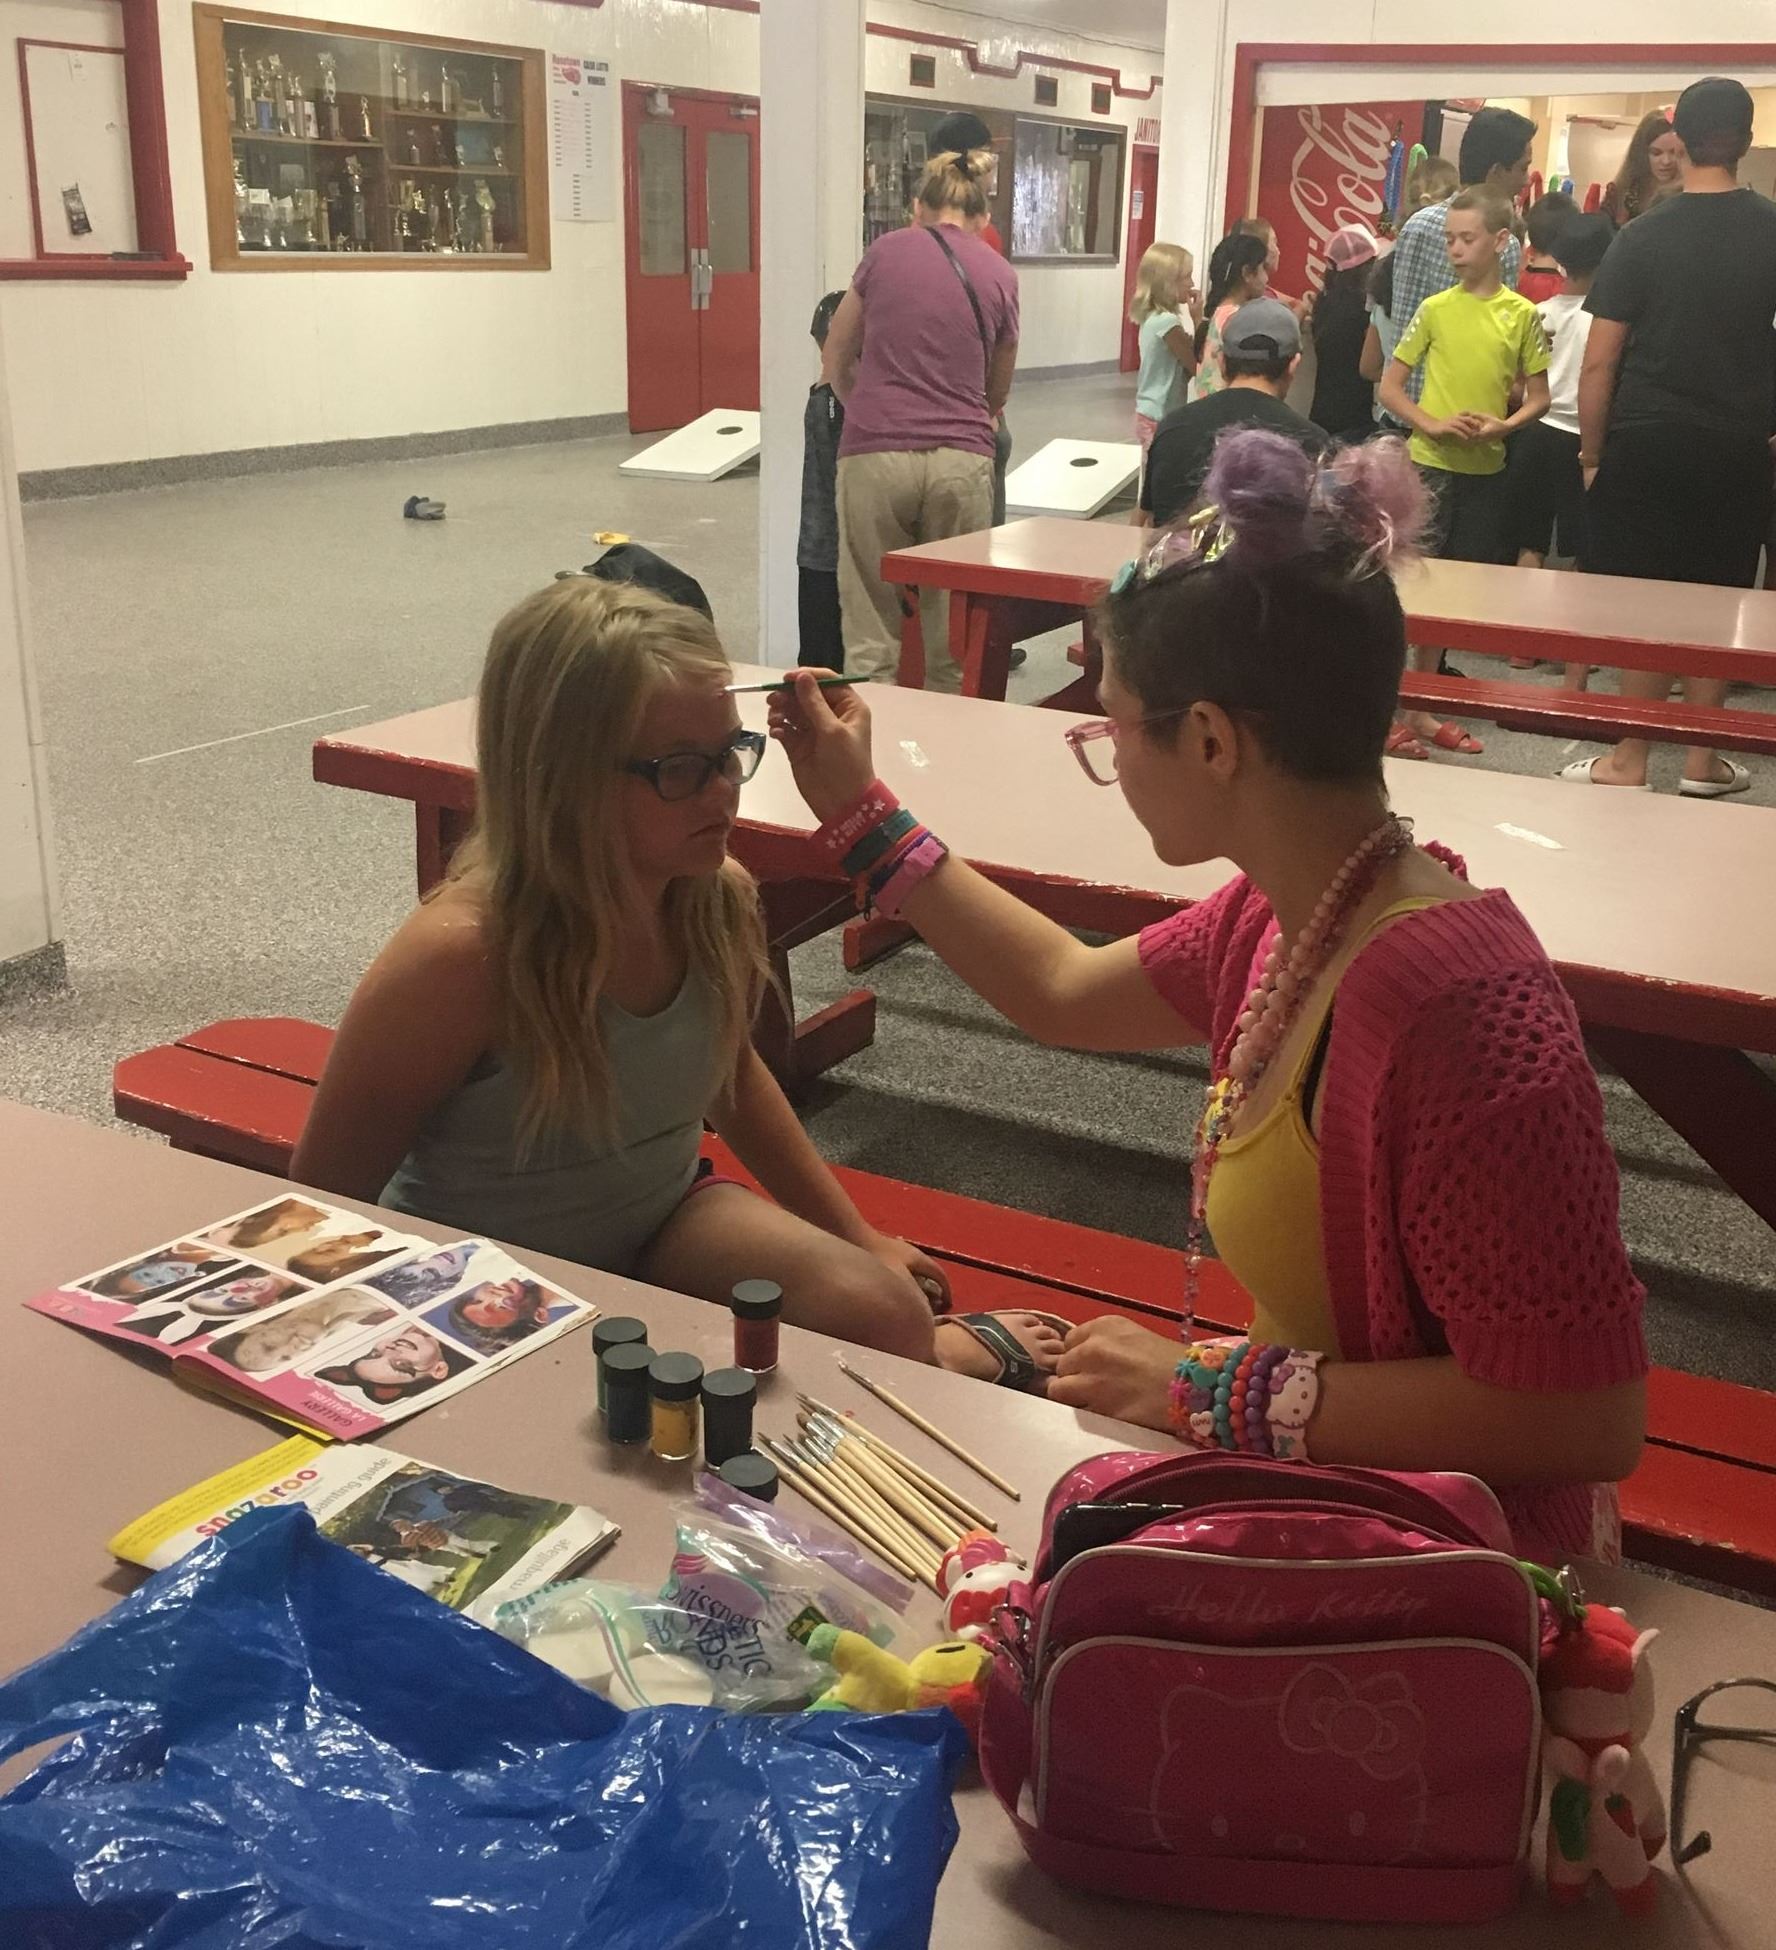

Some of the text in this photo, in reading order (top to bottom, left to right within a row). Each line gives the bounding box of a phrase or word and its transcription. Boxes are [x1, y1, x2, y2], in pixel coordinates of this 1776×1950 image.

[1134, 116, 1161, 143] JANITO
[301, 1400, 353, 1427] GALLERY
[196, 1469, 318, 1537] snazaroo
[314, 1478, 363, 1516] painting
[358, 1457, 393, 1483] guide
[510, 1538, 571, 1591] maquillage
